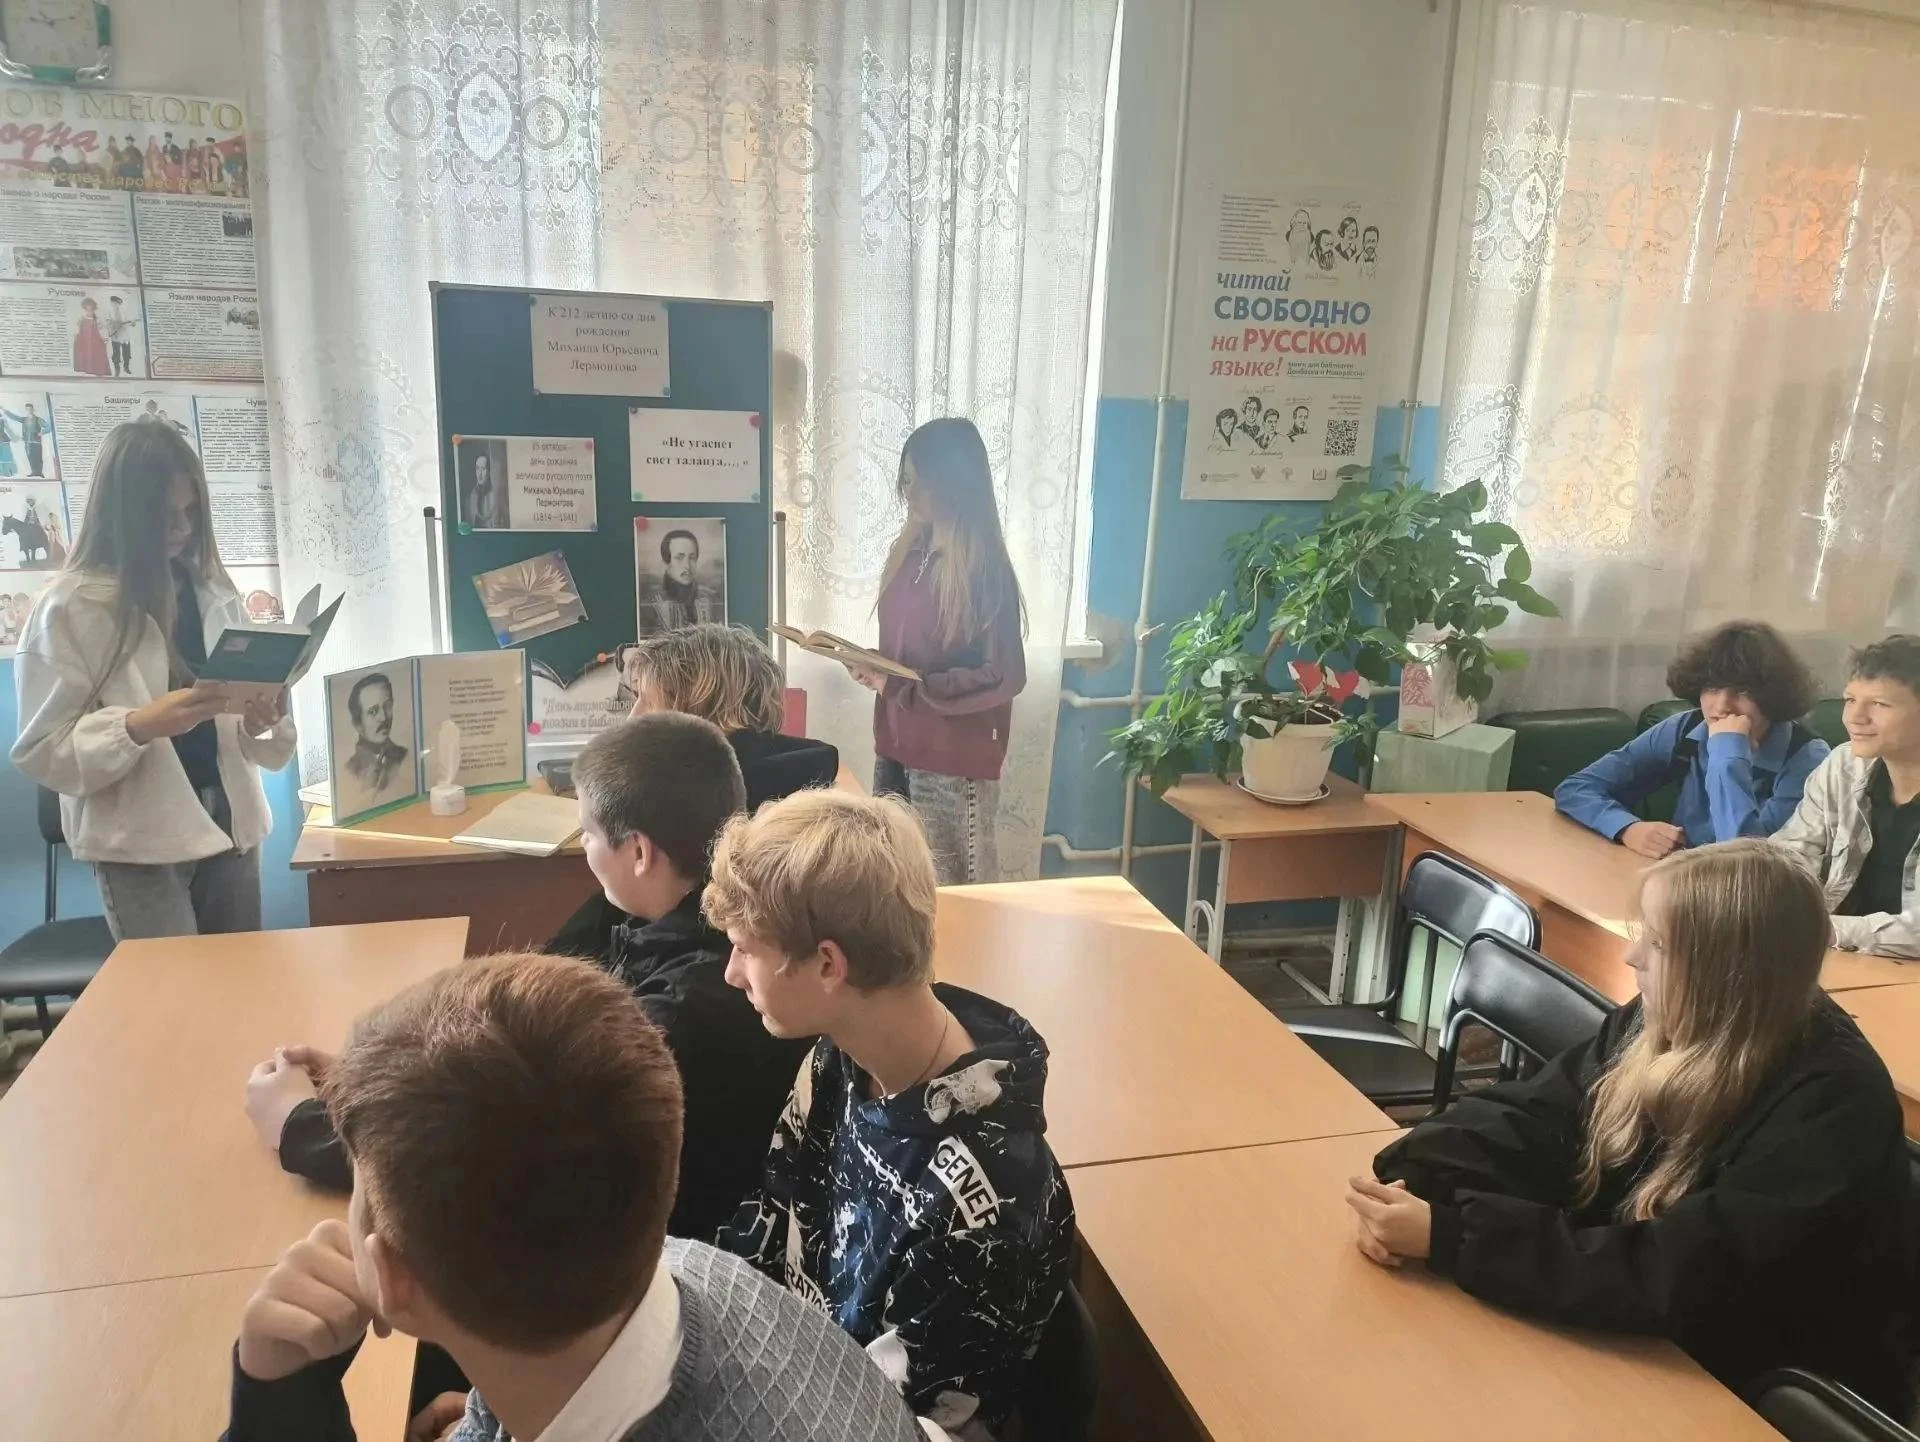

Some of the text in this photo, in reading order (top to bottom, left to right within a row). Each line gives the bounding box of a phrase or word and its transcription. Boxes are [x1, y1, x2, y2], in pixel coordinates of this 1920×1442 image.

[79, 92, 244, 131] МНОГО
[1217, 268, 1292, 292] читай
[197, 294, 231, 304] народов
[548, 307, 557, 318] К
[560, 307, 580, 318] 212
[620, 312, 634, 321] со
[1214, 295, 1371, 328] СВОБОДНО
[575, 326, 631, 338] рождения
[548, 341, 659, 357] Михаила Юрьевича
[1211, 327, 1368, 357] на РУССКОМ
[569, 359, 638, 373] Лермонтова
[1209, 356, 1284, 377] языке!
[104, 396, 141, 405] Башкиры
[662, 436, 733, 451] «Не угаснет
[646, 456, 672, 466] свет
[546, 473, 574, 483] русского
[523, 485, 585, 496] Михаила Юрьевича
